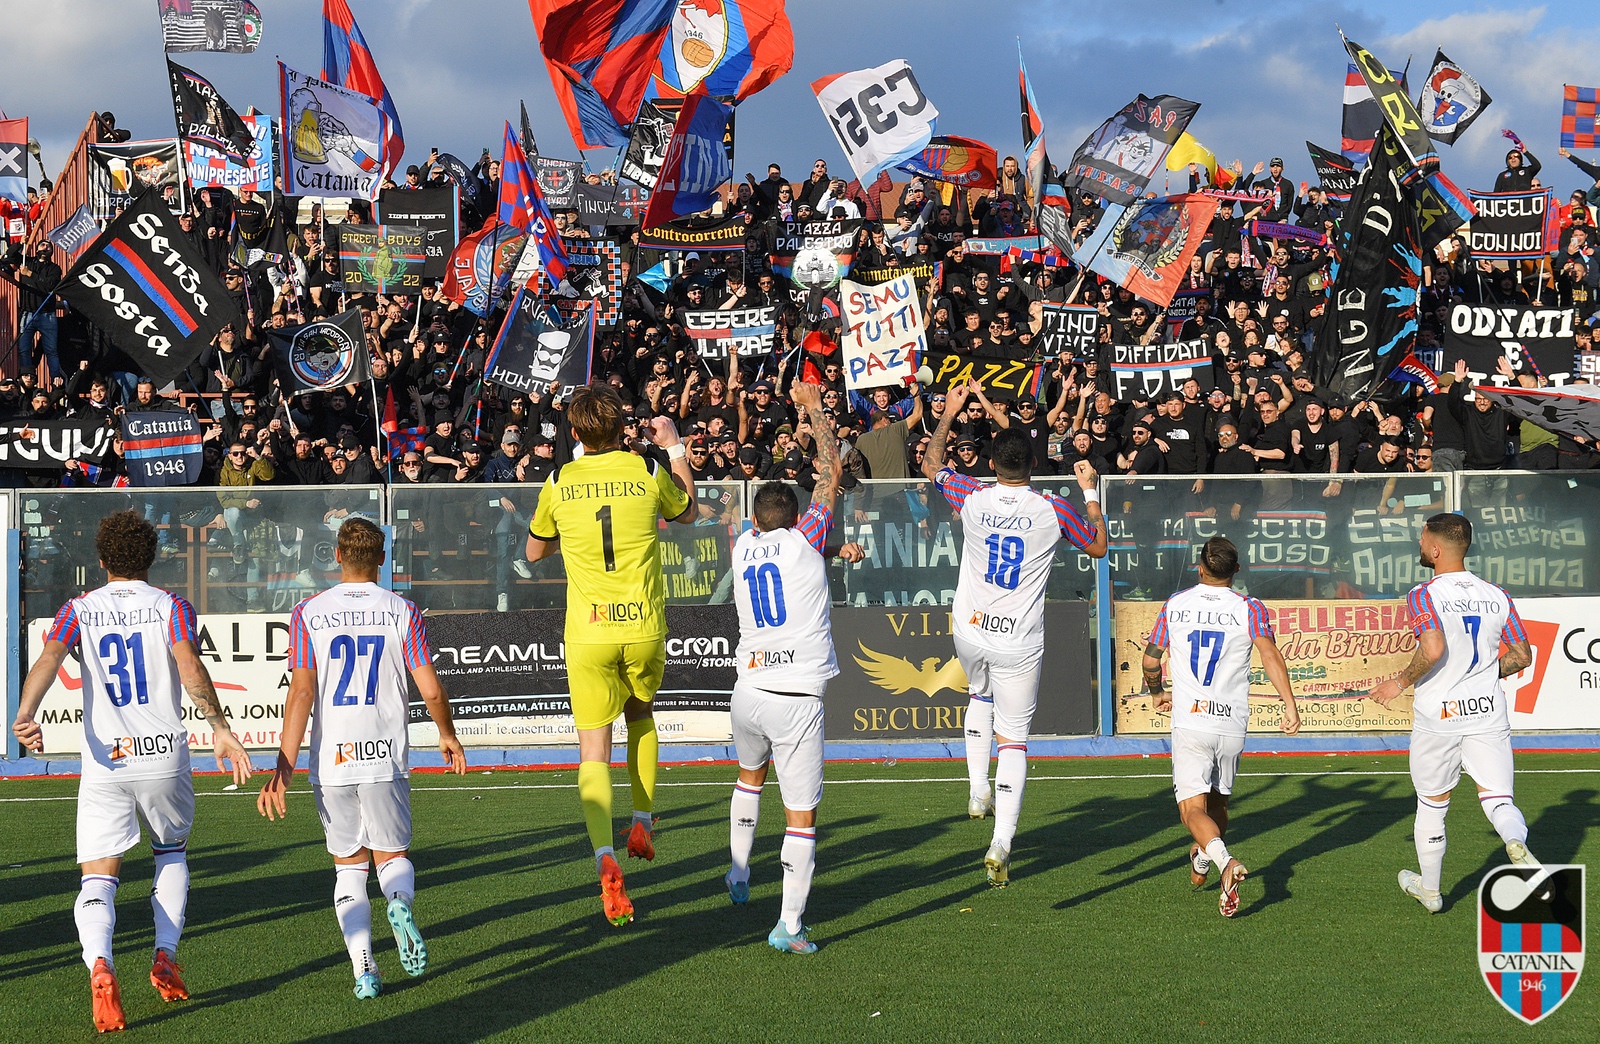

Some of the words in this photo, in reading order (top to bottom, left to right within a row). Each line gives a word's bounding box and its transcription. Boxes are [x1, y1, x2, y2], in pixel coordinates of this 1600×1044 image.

[684, 28, 704, 40] 1946
[296, 165, 372, 192] Catania
[1474, 196, 1544, 217] ANGELO
[342, 233, 377, 244] STREET
[388, 235, 421, 246] BOYS
[643, 224, 746, 243] Controcorrente
[786, 222, 842, 235] PIAZZA
[776, 236, 853, 250] PALESTRO
[1472, 233, 1508, 251] CON
[1511, 232, 1542, 251] NOI
[129, 213, 208, 317] Senza
[346, 272, 362, 283] 20
[403, 275, 420, 287] 22
[849, 278, 909, 315] SEMU
[78, 263, 172, 357] Sosta
[684, 306, 776, 330] ESSERE
[1451, 305, 1574, 338] ODIATI
[847, 304, 917, 348] TUTTI
[1115, 339, 1207, 363] DIFFIDATI
[1501, 342, 1524, 371] E
[128, 417, 193, 436] Catania
[145, 459, 185, 477] 1946
[560, 481, 646, 502] BETHERS
[980, 512, 1032, 531] RIZZO
[596, 505, 616, 572] 1
[743, 543, 781, 562] LODI
[984, 533, 1026, 591] 18
[743, 562, 787, 629] 10
[589, 601, 644, 623] TRILOGY
[886, 612, 952, 636] V.I.
[1169, 610, 1191, 623] DE
[665, 637, 730, 656] cron
[1282, 630, 1321, 660] da
[1326, 629, 1417, 659] Bruno
[1462, 615, 1482, 674] 7
[100, 632, 149, 707] 31
[485, 664, 533, 673] ATHLEISURE
[1187, 629, 1225, 687] 17
[330, 635, 385, 706] 27
[853, 706, 967, 731] SECURI
[1343, 702, 1365, 714] (RC)
[1440, 695, 1495, 720] TRILOGY
[111, 733, 173, 761] TRILOGY
[335, 738, 393, 765] TRILOGY
